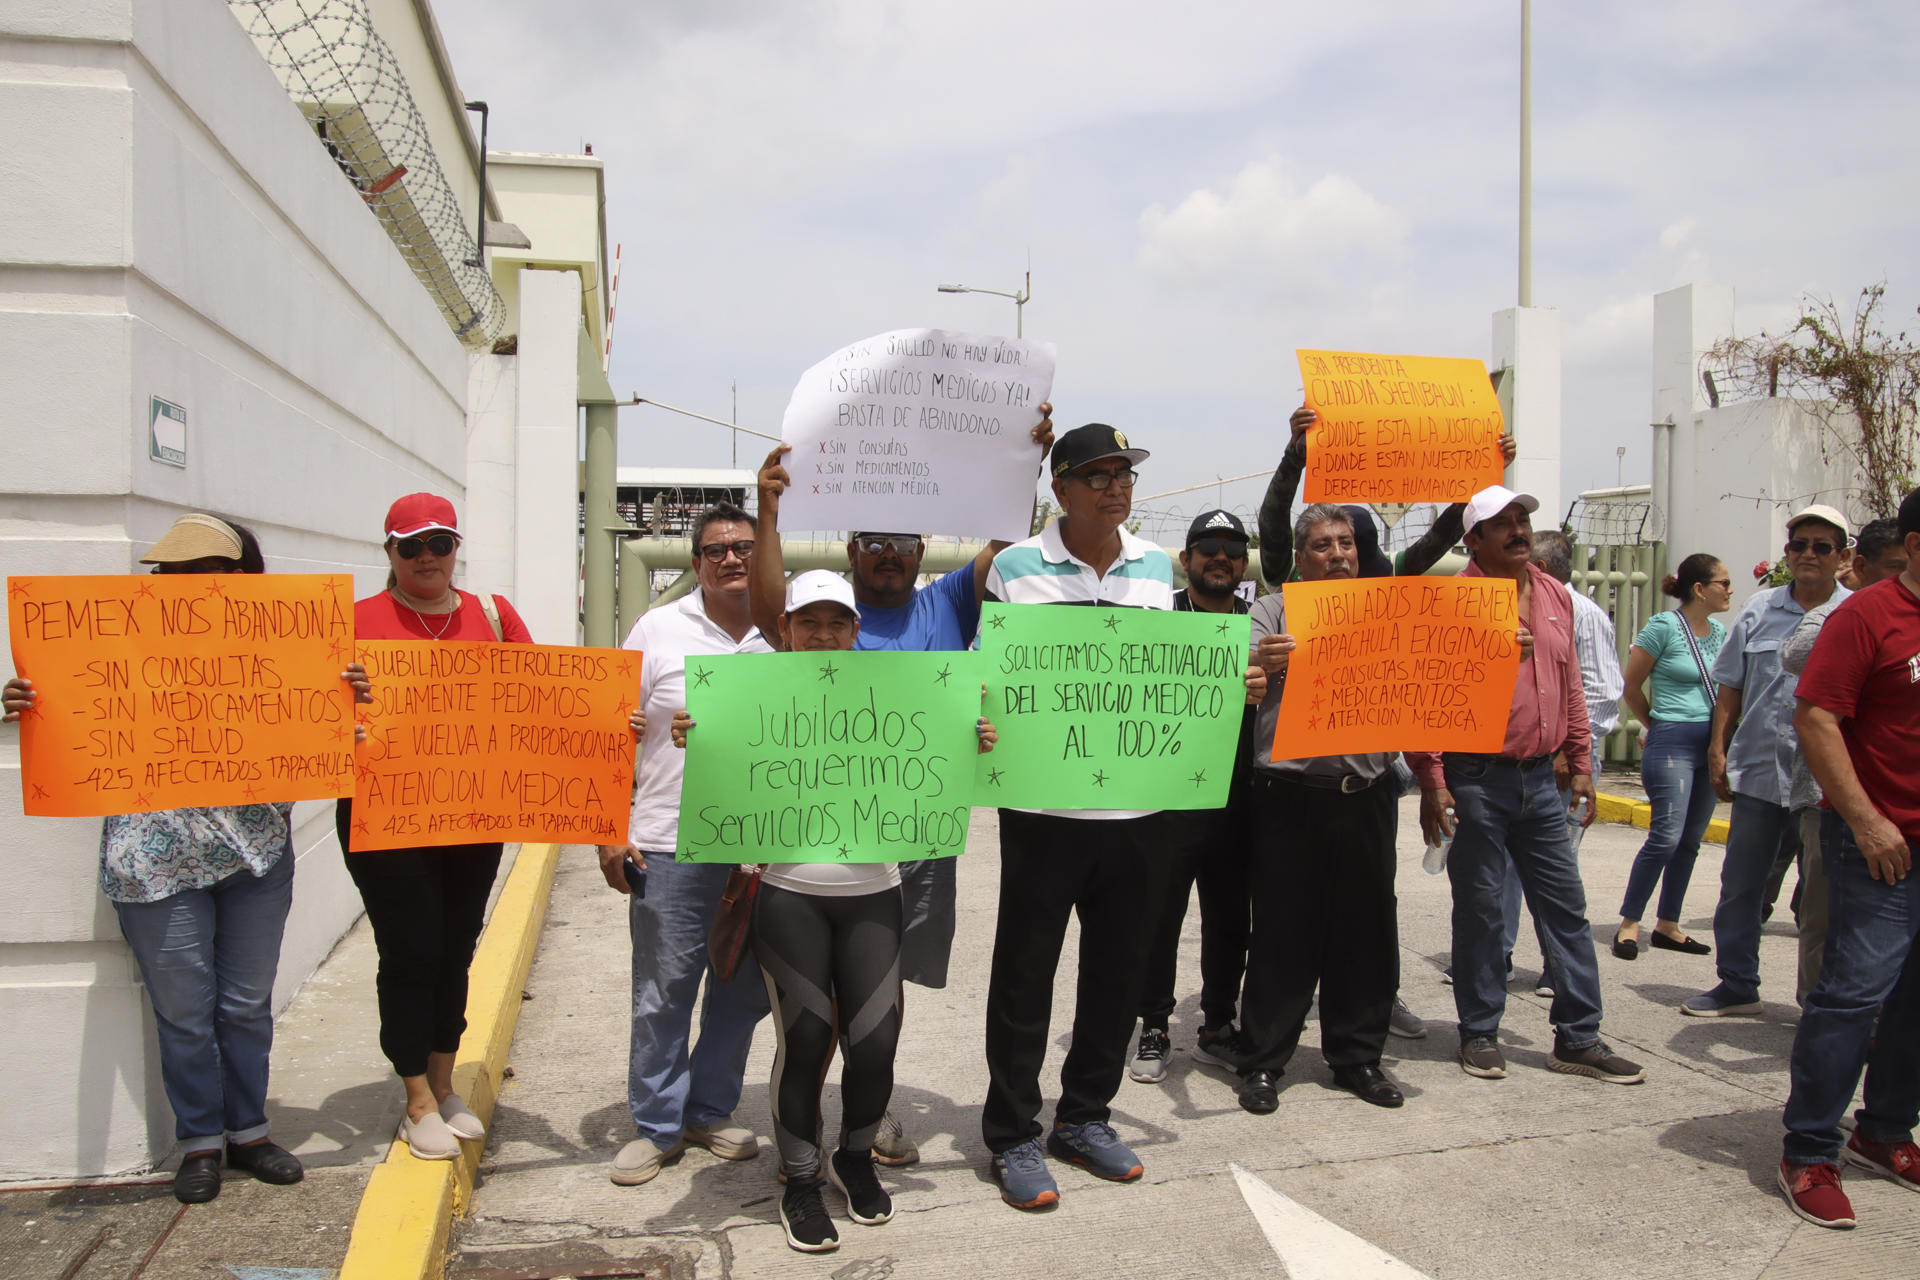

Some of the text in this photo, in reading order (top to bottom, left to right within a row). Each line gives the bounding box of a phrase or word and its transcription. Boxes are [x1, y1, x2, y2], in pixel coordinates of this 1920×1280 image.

[886, 335, 935, 357] SALUD
[941, 343, 958, 360] NO
[964, 343, 988, 362] HAY
[1331, 355, 1408, 378] PRESIDENTA
[1004, 381, 1030, 408] YA!
[1311, 378, 1379, 407] CLAUDIA
[835, 403, 884, 428] BASTA
[893, 406, 911, 428] DE
[1316, 420, 1368, 448] ¿DONDE
[1376, 418, 1412, 446] ESTA
[1418, 415, 1438, 447] LA
[1376, 450, 1415, 469] ESTAN
[1420, 447, 1492, 471] NUESTROS
[1324, 478, 1395, 498] DERECHOS
[23, 595, 348, 642] PEMEX NOS ABANDONA
[1309, 585, 1515, 631] JUBILADOS DE PEMEX
[1000, 641, 1239, 679] SOLICITAMOS REACTIVACION
[1307, 622, 1514, 666] TAPACHULA EXIGIMOS
[141, 654, 283, 690] CONSULTAS
[367, 647, 609, 682] JUBILADOS PETROLEROS
[1331, 657, 1487, 686] CONSULTAS MEDICAS
[151, 687, 343, 725] MEDICAMENTOS
[490, 682, 591, 719] PEDIMOS
[1005, 682, 1224, 719] DEL SERVICIO MEDICO
[1330, 683, 1470, 709] MEDICAMENTOS
[748, 686, 927, 752] Jubilados
[1327, 707, 1401, 731] ATENCION
[153, 725, 245, 756] SALUD
[369, 723, 632, 765] SE VUELVA A PROPORCIONAR
[1063, 719, 1183, 760] AL 100%
[144, 758, 262, 789] AFECTADOS
[266, 752, 356, 782] TAPACHULA
[749, 753, 949, 800] requerimos
[367, 767, 604, 812] ATENCION MEDICA
[382, 811, 617, 839] 425 AFECTADOS EN TAPACHULA
[853, 793, 968, 848] Medicos
